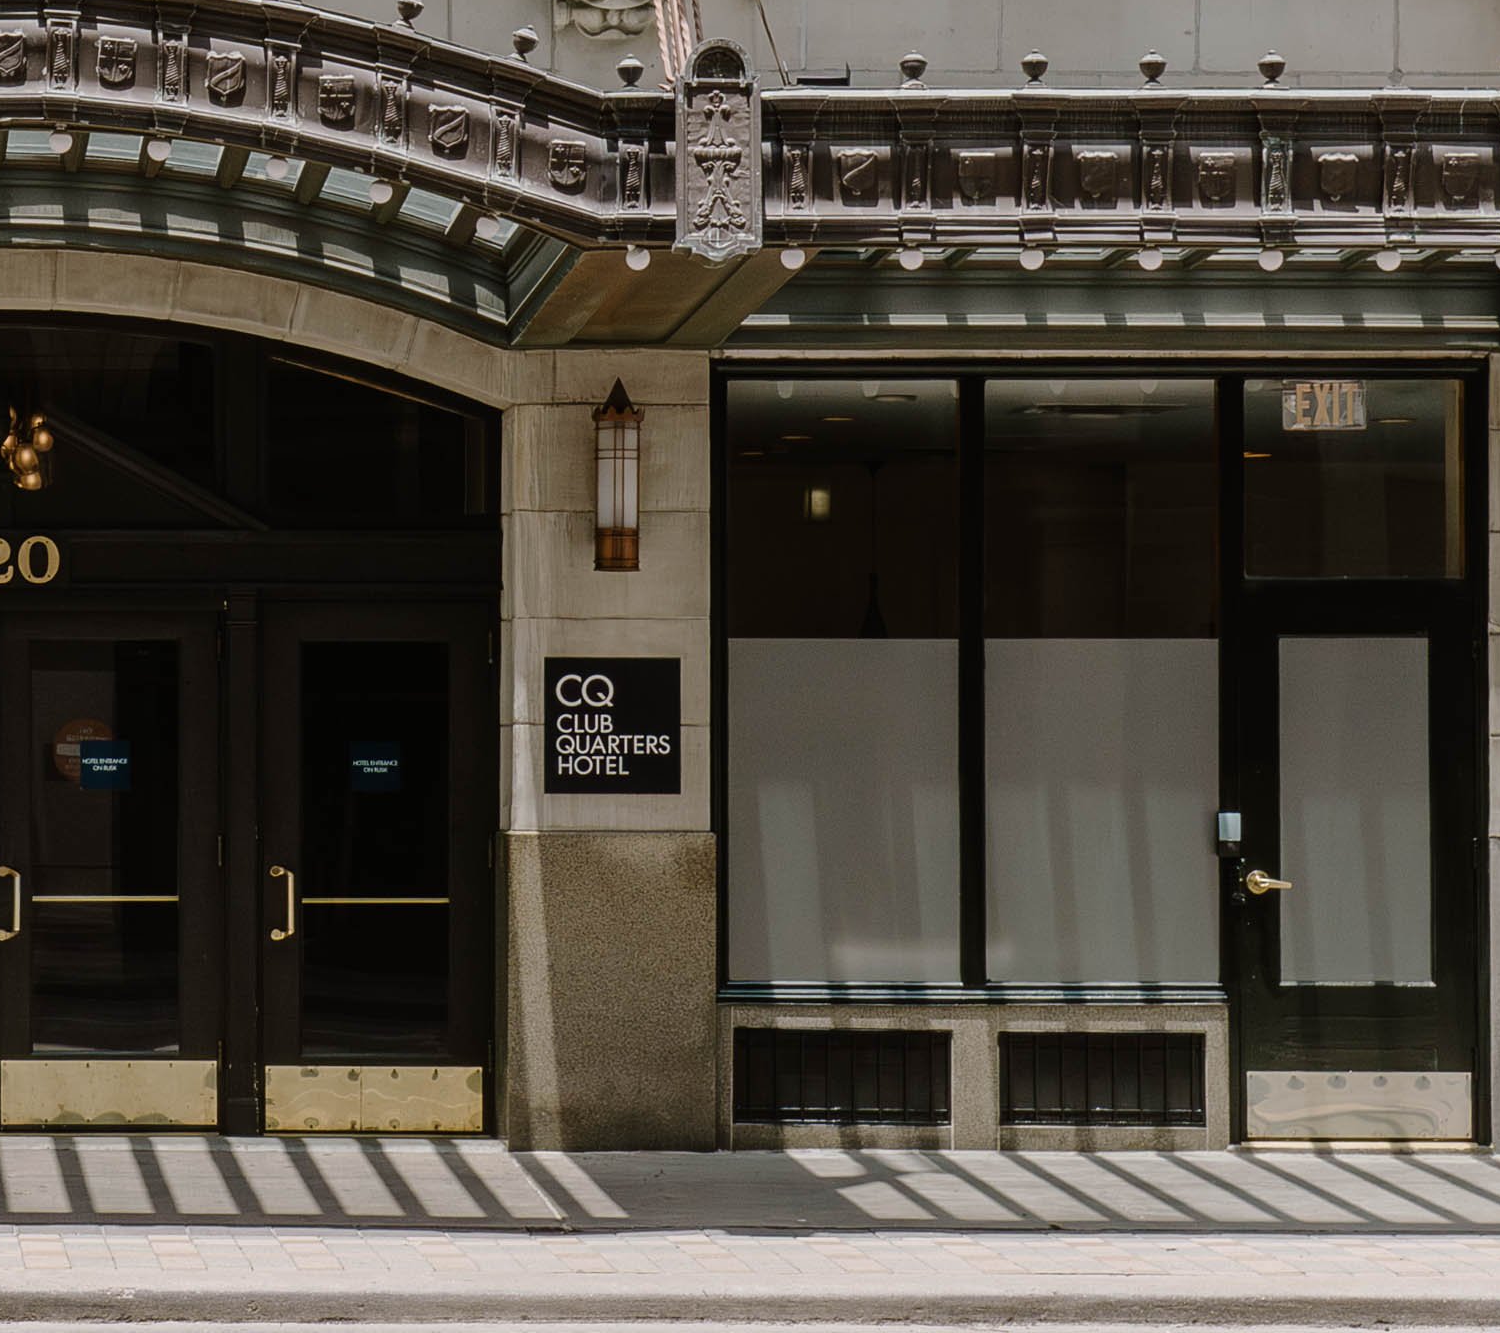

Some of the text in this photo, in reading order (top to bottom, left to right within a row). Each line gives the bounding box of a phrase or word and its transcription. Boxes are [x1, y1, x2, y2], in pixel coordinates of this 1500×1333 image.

[1296, 383, 1359, 426] EXIT
[555, 674, 614, 707] CQ
[556, 714, 614, 733] CLUB
[555, 735, 671, 754] QUARTERS
[558, 755, 630, 775] HOTEL
